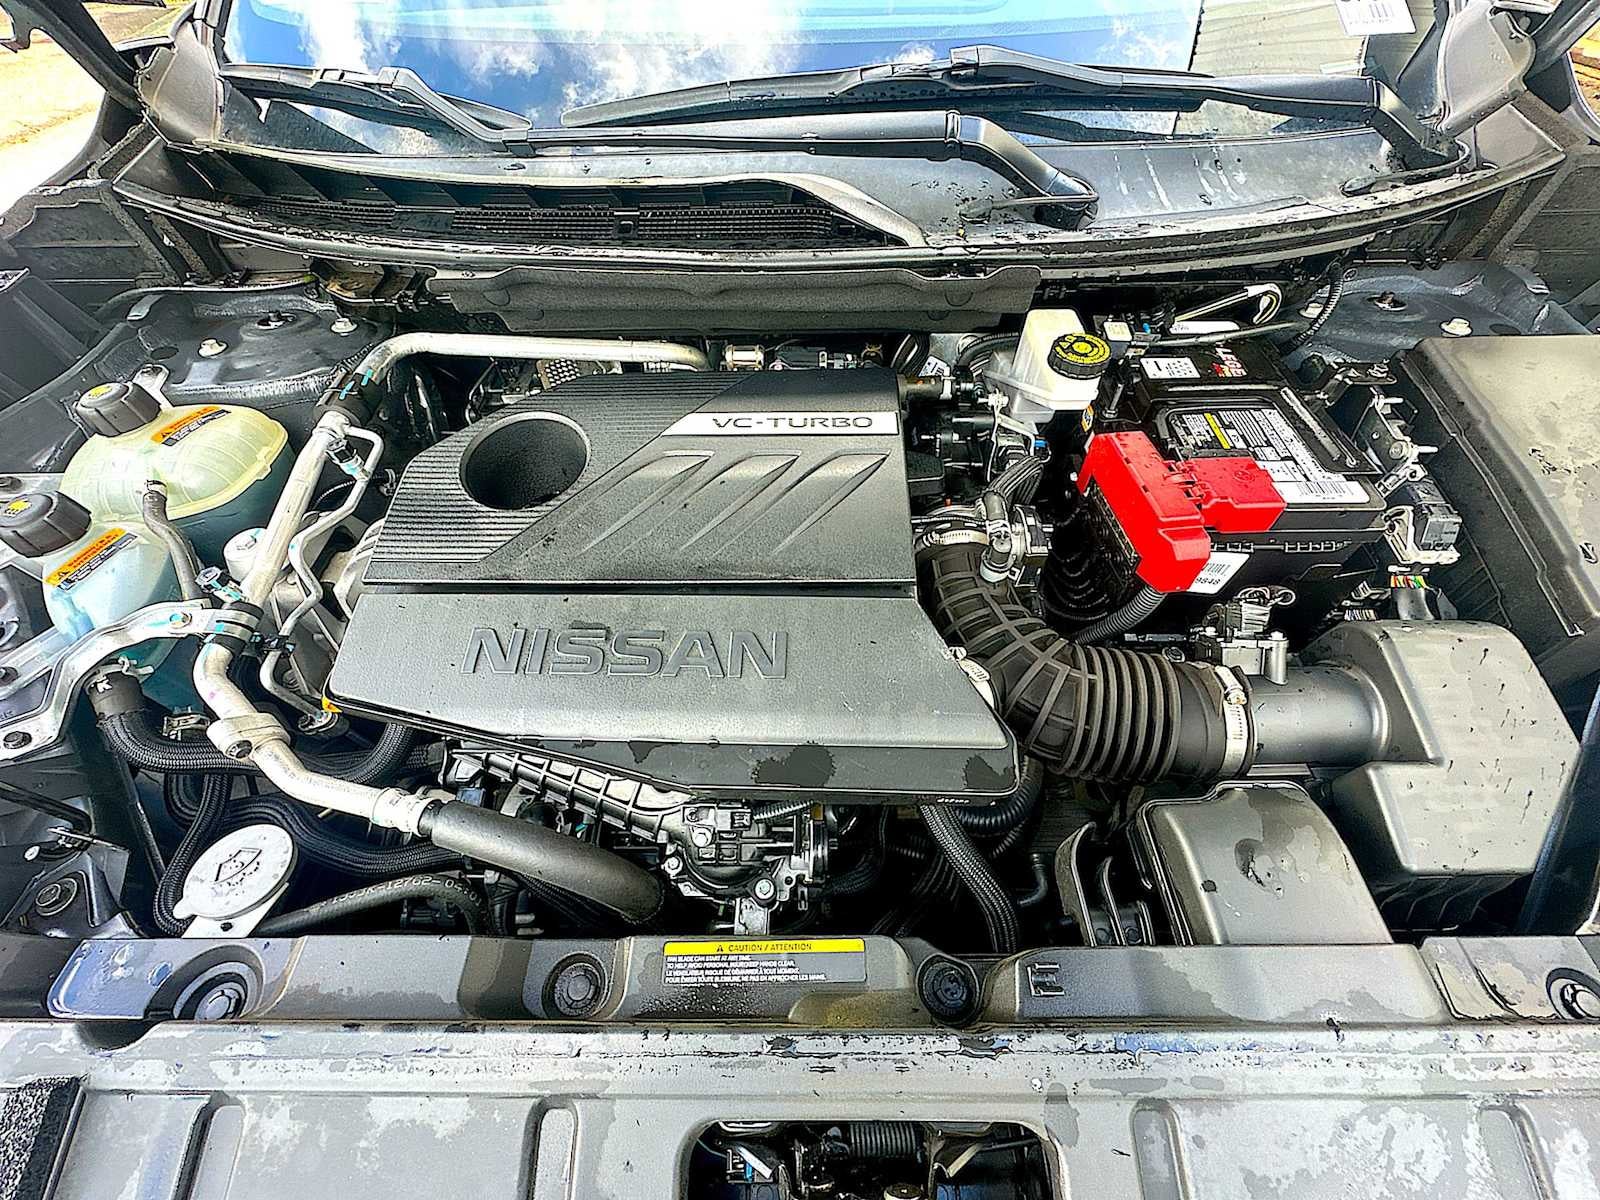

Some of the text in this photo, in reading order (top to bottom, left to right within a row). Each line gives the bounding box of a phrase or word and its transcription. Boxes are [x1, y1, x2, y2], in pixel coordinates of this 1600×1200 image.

[712, 416, 873, 428] VC-TURBO
[460, 627, 789, 680] NISSAN
[728, 944, 763, 952] CAUTION
[770, 943, 812, 951] ATTENTION
